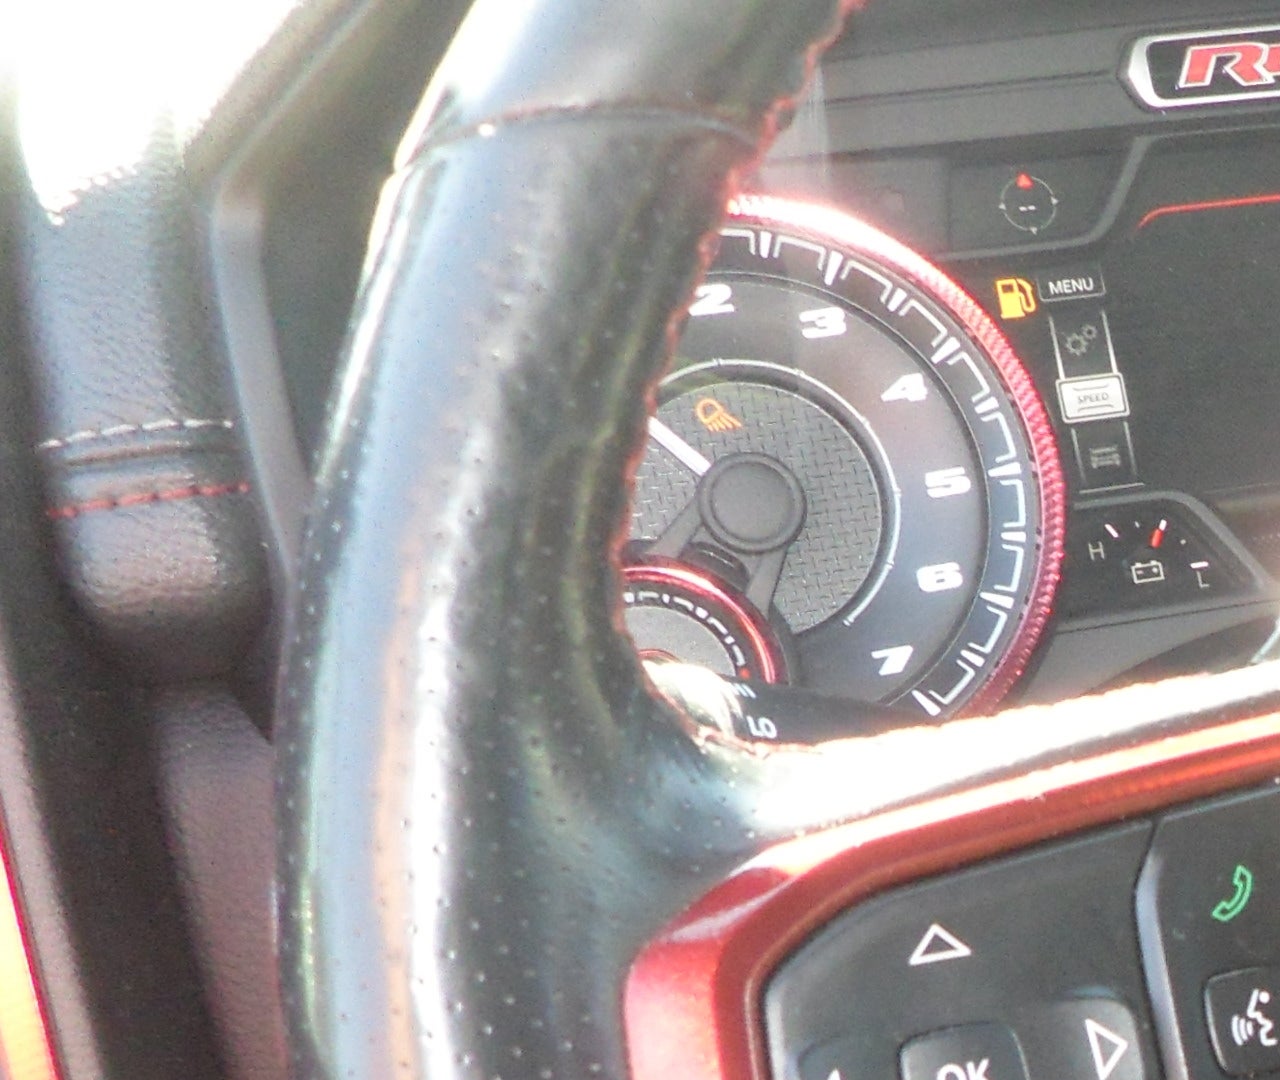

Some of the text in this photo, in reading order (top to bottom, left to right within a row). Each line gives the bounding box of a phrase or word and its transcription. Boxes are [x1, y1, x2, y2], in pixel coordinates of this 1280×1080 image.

[688, 283, 735, 317] 2
[1048, 275, 1094, 296] MENU
[800, 306, 847, 339] 3
[881, 372, 928, 402] 4
[1077, 391, 1110, 406] SPEED
[924, 467, 972, 499] 5
[915, 562, 963, 593] 6
[871, 645, 915, 677] 7
